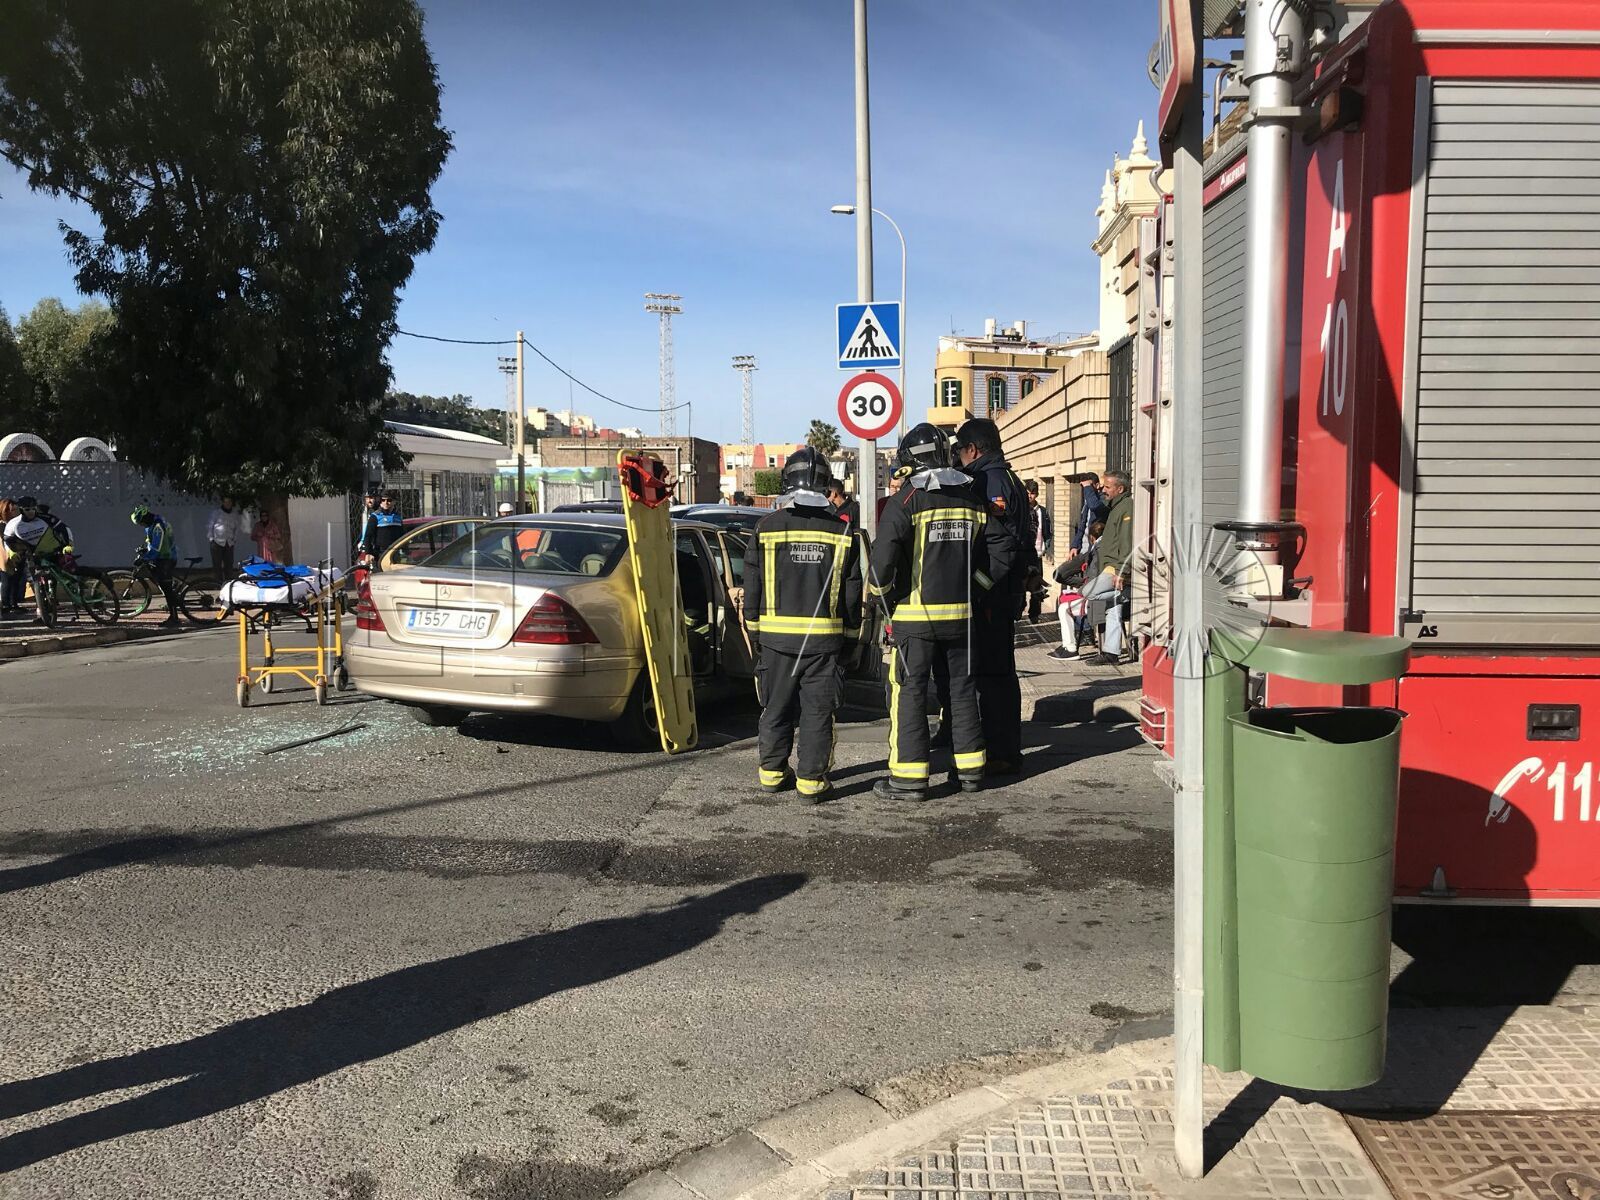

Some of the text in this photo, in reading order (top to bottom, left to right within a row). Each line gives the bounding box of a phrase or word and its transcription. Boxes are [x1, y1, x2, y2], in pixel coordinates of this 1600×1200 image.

[1320, 159, 1348, 416] A 10
[852, 395, 887, 417] 30
[418, 611, 451, 627] 1557
[1417, 625, 1439, 639] AS
[1547, 761, 1600, 822] 11
